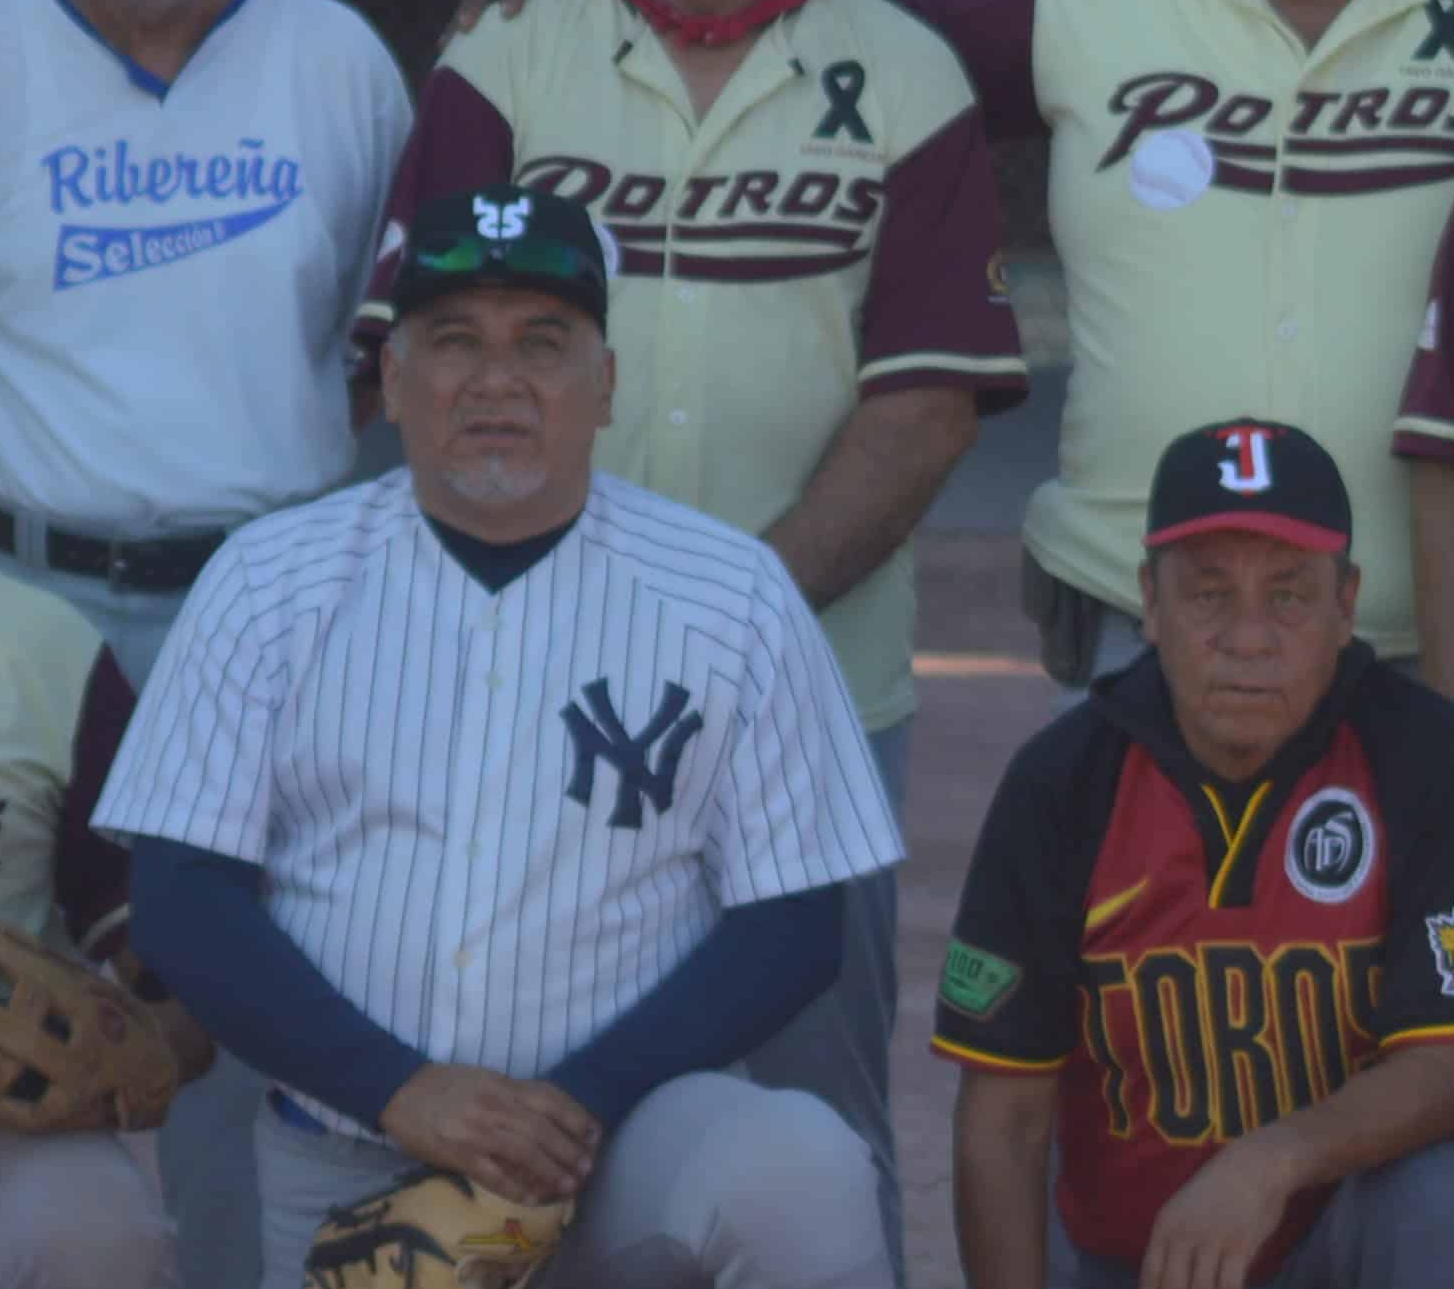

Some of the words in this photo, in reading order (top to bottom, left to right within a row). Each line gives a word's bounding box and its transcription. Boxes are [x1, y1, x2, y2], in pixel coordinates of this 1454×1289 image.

[41, 139, 303, 215] Ribereña
[514, 155, 887, 225] POTROS
[559, 676, 704, 830] NY
